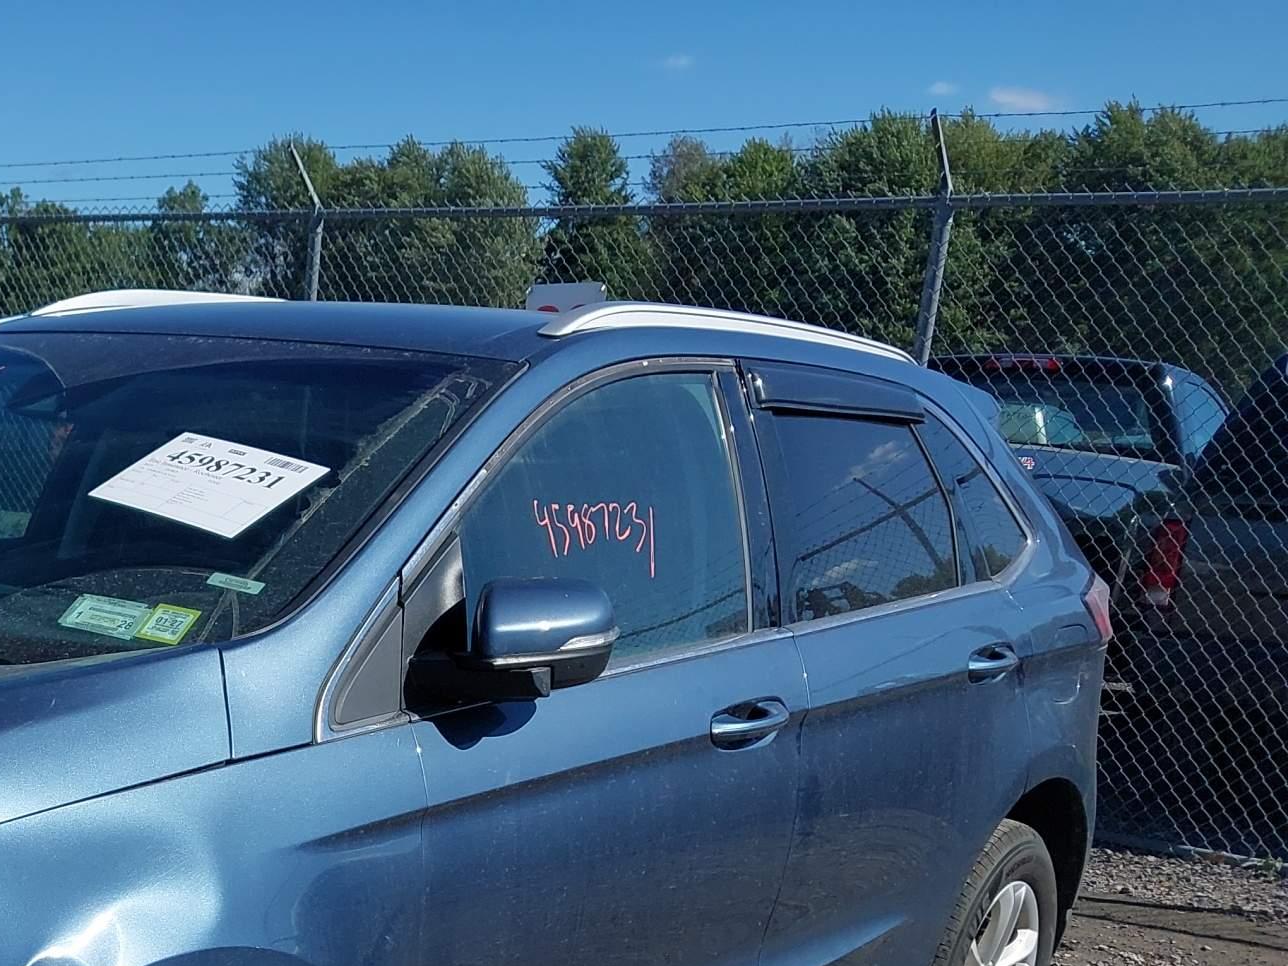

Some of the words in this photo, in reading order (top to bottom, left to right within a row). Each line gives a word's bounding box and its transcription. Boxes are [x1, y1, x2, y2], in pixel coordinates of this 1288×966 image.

[166, 449, 286, 489] 45987231
[533, 499, 655, 579] 45987231
[116, 620, 134, 630] 28
